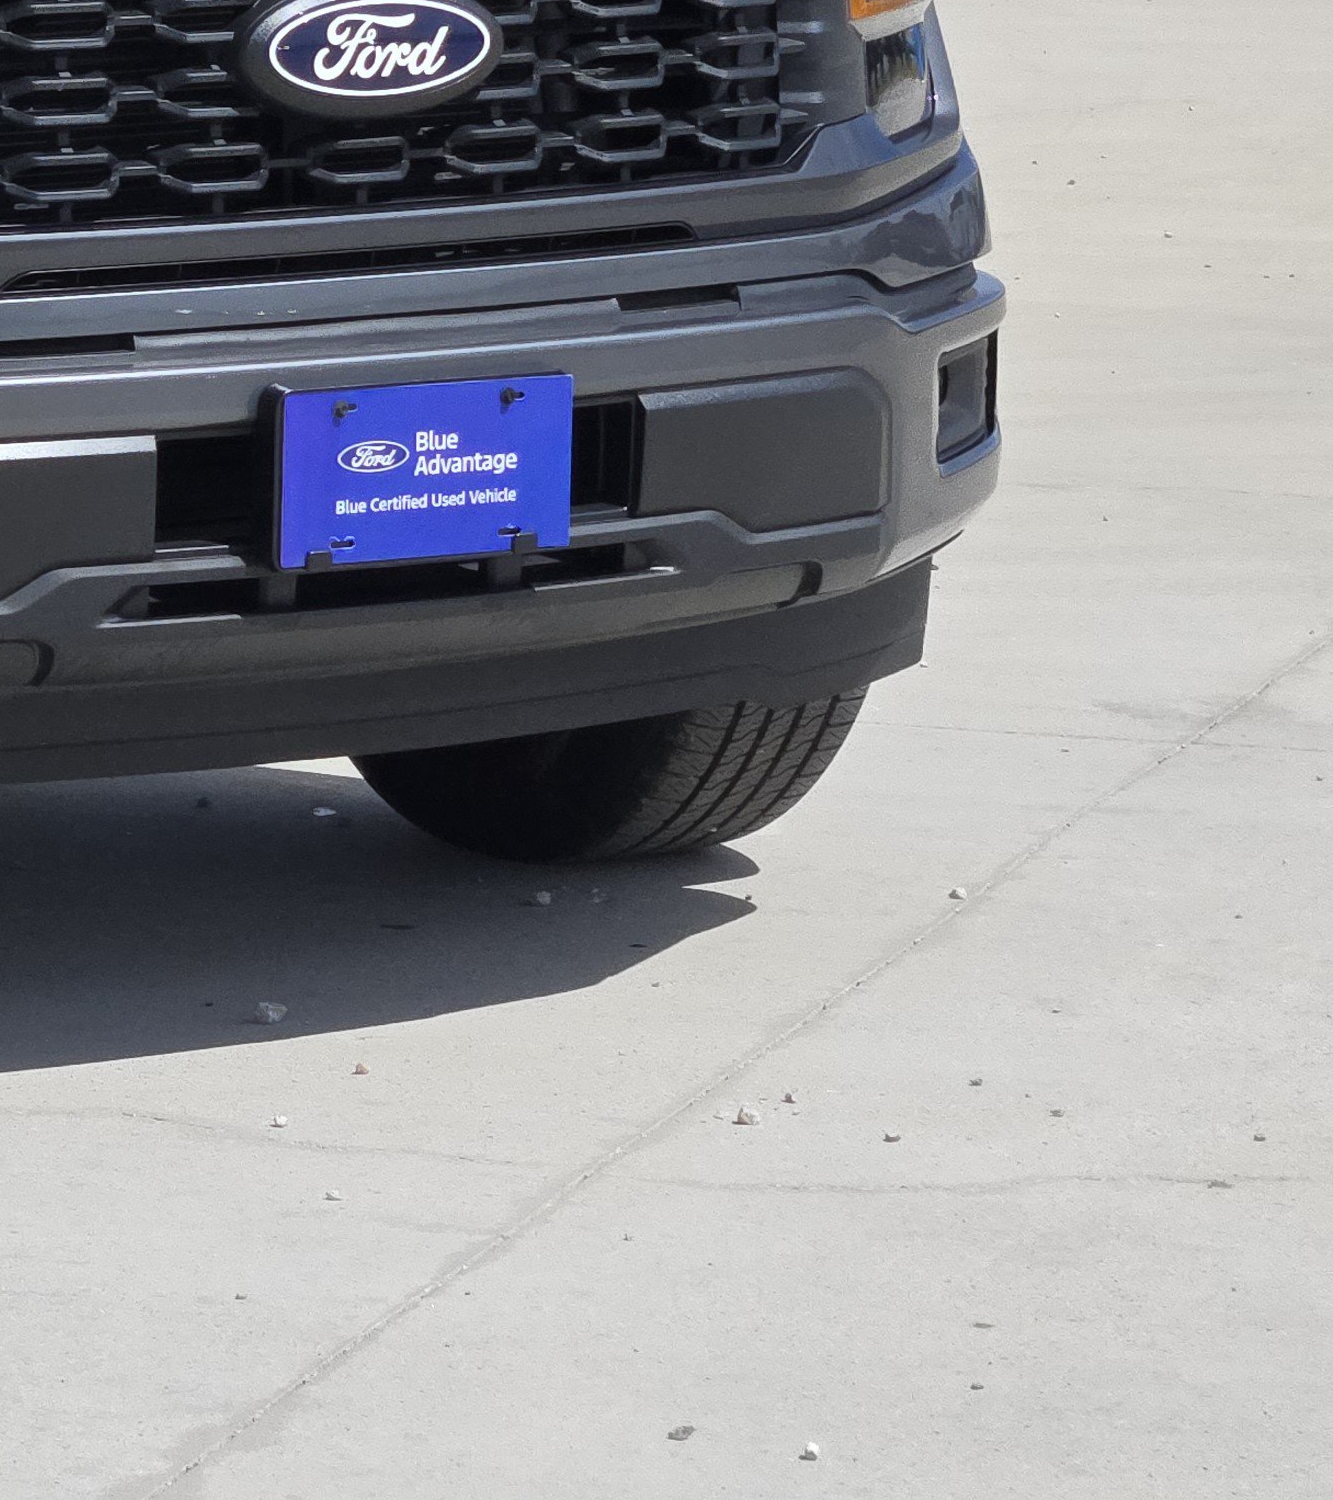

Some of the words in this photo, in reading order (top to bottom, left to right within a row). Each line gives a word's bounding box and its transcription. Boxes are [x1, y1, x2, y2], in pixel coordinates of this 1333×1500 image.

[313, 12, 450, 81] Ford
[415, 430, 459, 452] Blue
[350, 445, 398, 469] Ford
[413, 451, 518, 477] Advantage
[335, 499, 367, 515] Blue
[370, 493, 428, 512] Certified
[431, 490, 466, 508] Used
[469, 486, 517, 505] Vehicle
